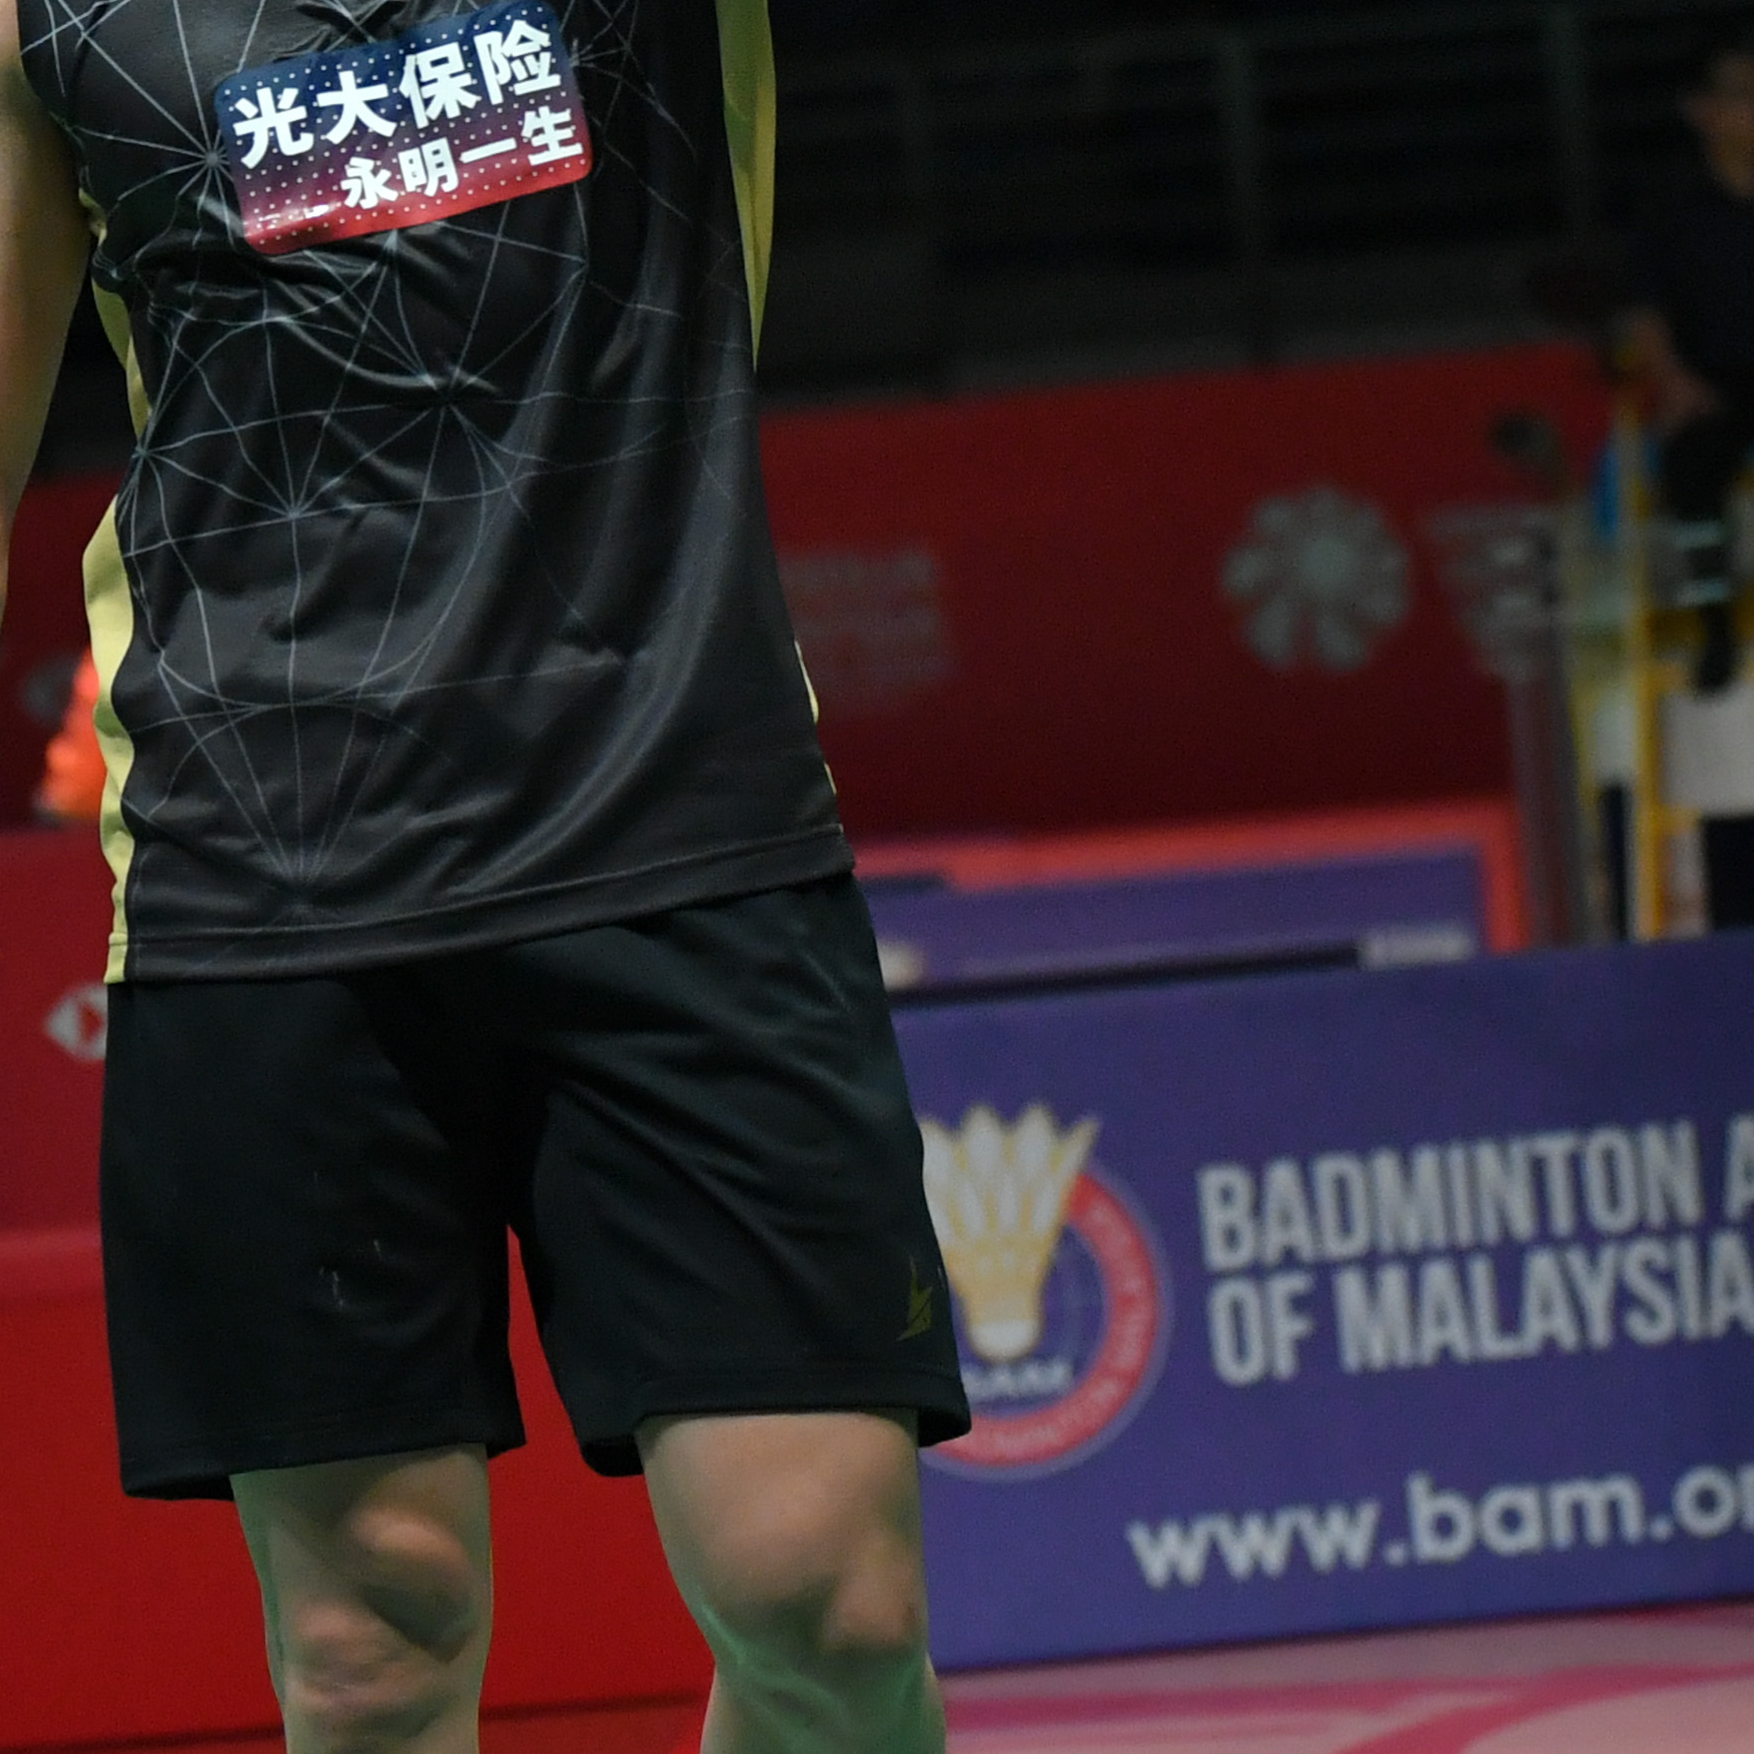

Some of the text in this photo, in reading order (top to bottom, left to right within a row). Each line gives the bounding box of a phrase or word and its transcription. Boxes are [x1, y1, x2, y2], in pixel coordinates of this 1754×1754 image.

[232, 19, 562, 169] 光大保险
[340, 105, 585, 210] 永明一生
[1196, 1120, 1703, 1272] BADMINTON
[1207, 1269, 1314, 1387] OF
